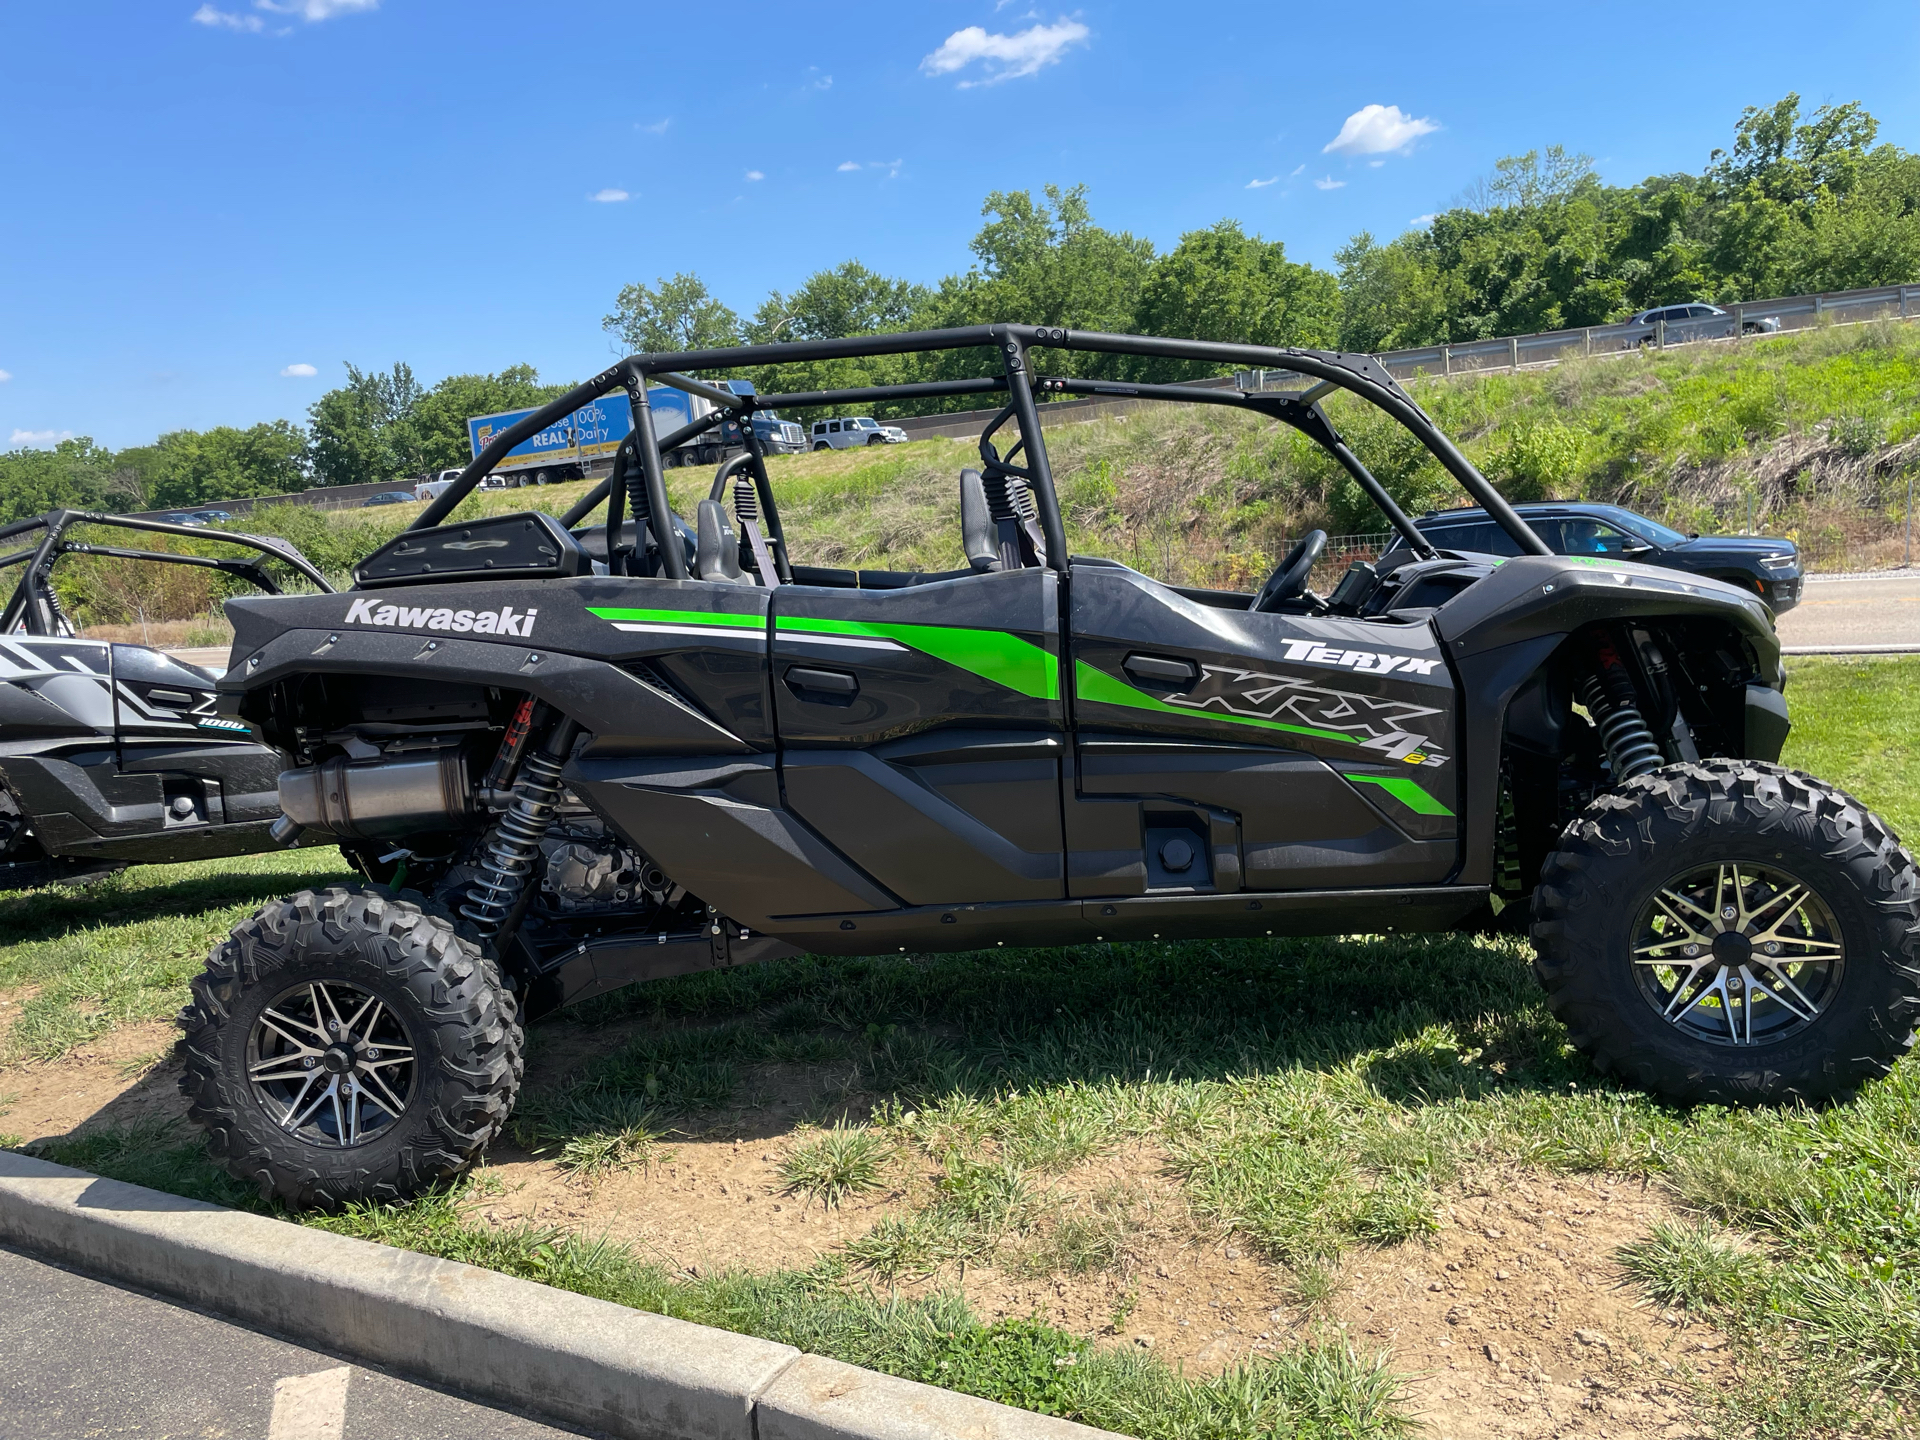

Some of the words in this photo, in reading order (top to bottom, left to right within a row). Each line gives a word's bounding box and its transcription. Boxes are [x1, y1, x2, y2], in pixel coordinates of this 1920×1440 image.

[532, 431, 566, 447] REAL
[578, 427, 609, 441] Dairy
[344, 598, 538, 638] Kawasaki
